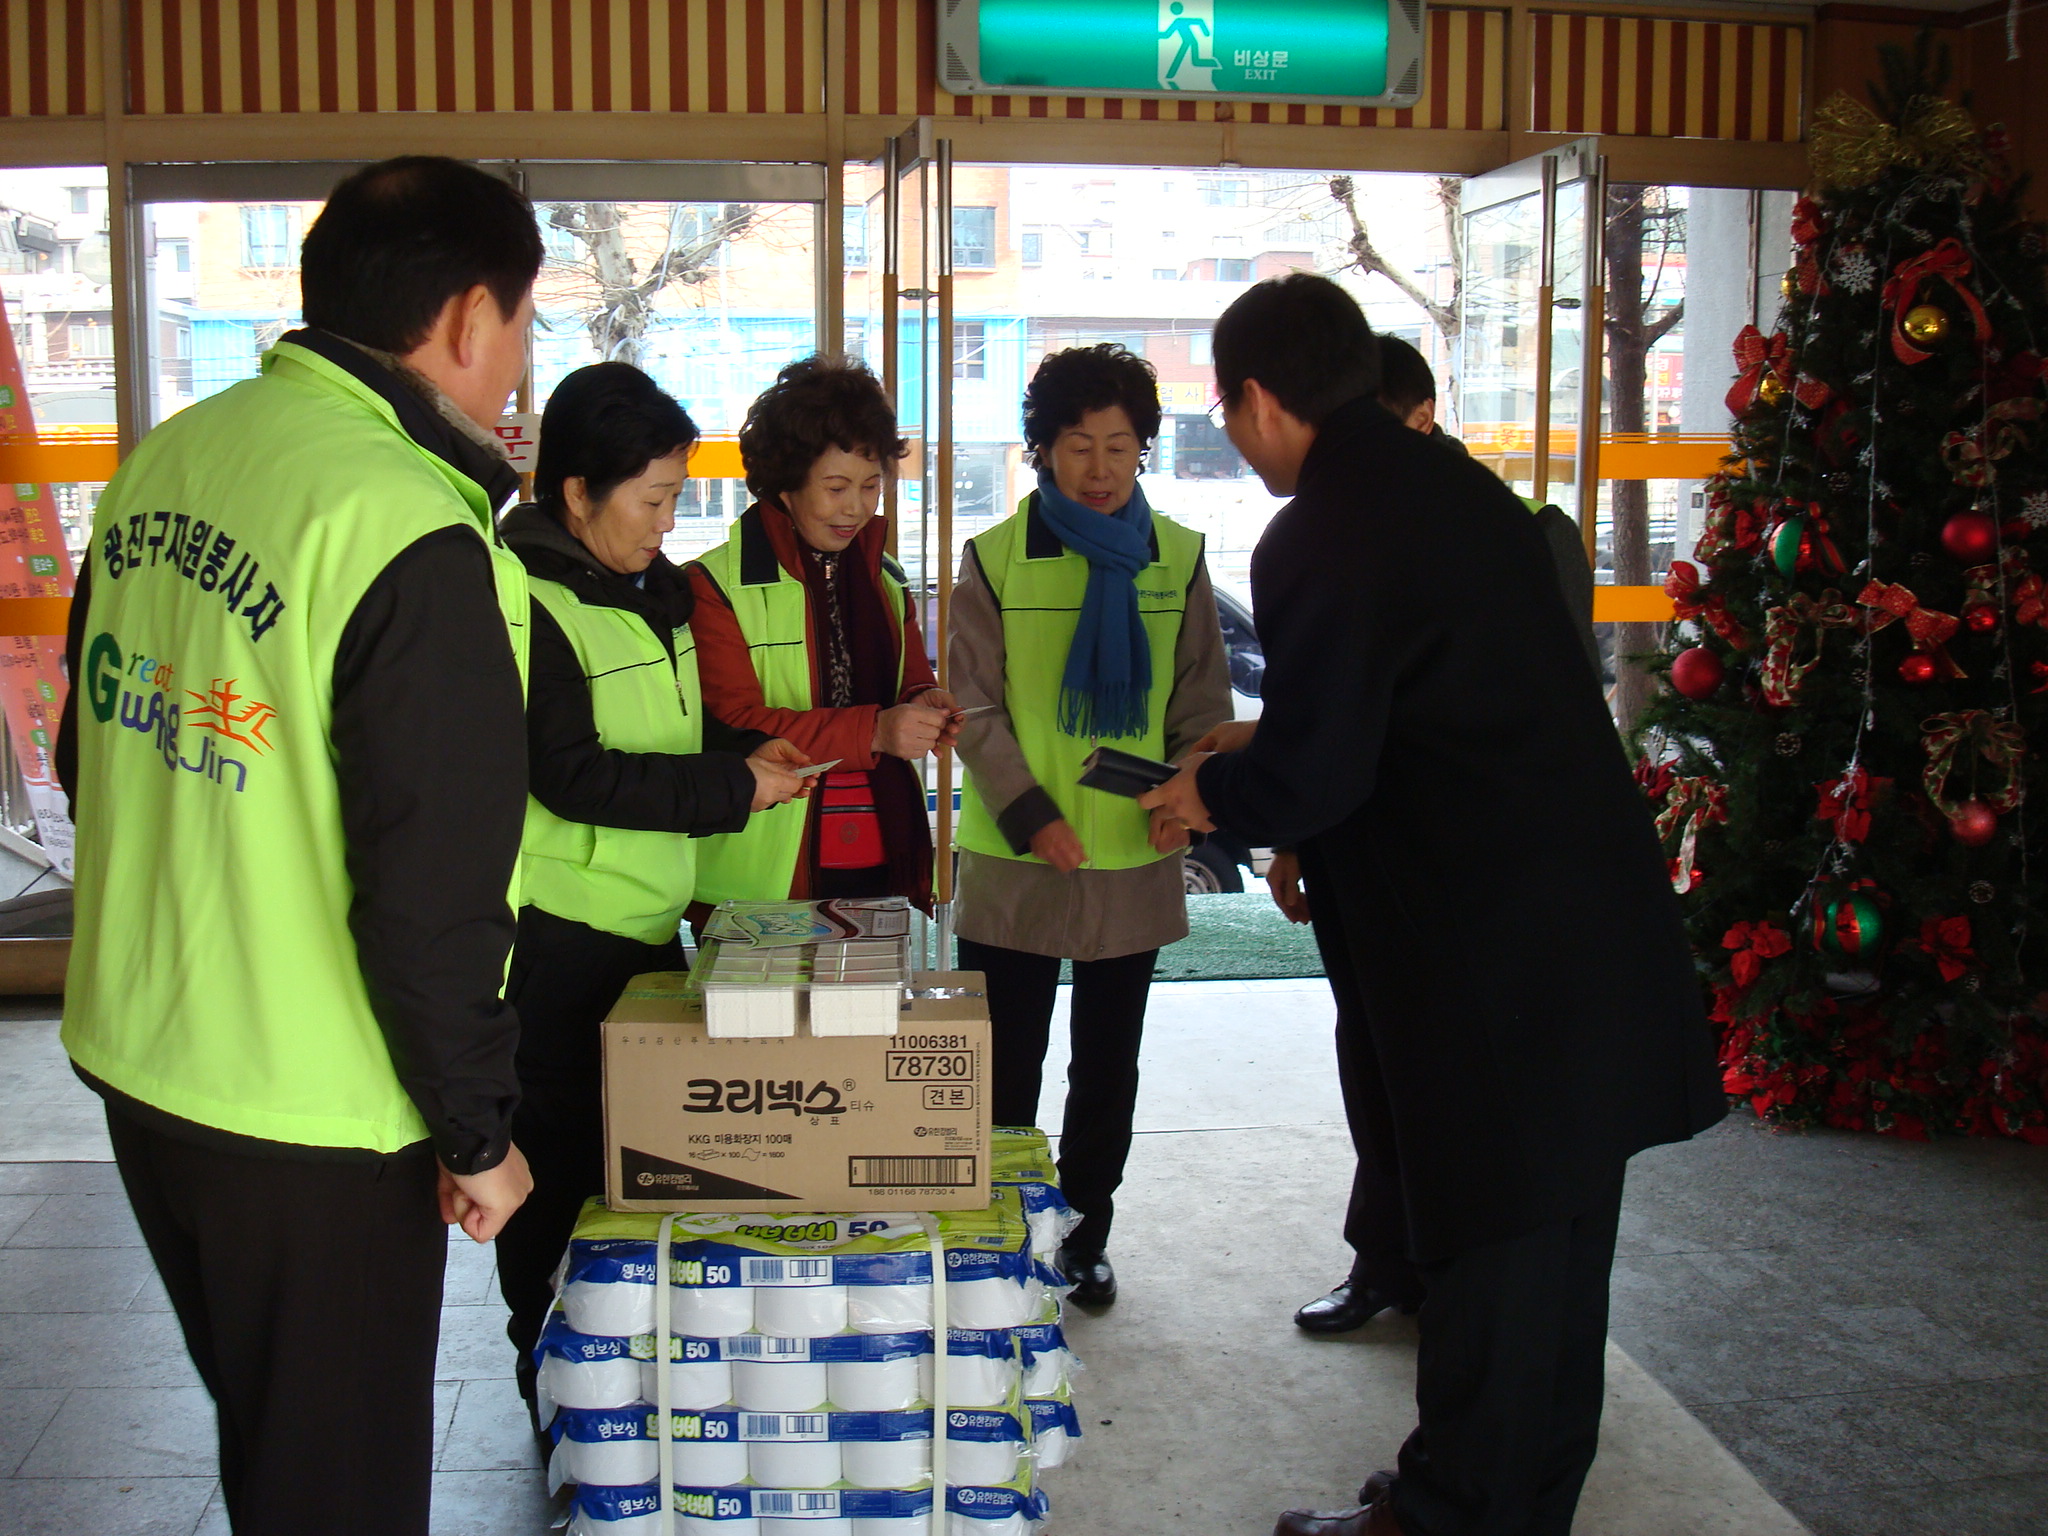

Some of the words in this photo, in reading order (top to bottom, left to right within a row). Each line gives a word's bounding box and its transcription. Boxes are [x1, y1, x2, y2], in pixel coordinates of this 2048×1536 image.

[1234, 50, 1288, 67] 비상문
[1244, 69, 1277, 80] EXIT
[494, 426, 533, 460] 문
[104, 511, 285, 643] 광진구자원봉사자
[889, 1035, 968, 1049] 11006381
[892, 1055, 967, 1077] 78730
[682, 1078, 848, 1117] 크리넥스
[850, 1099, 875, 1112] 티슈
[688, 1134, 711, 1145] KKG
[714, 1133, 762, 1145] 미용화장지
[765, 1133, 793, 1145] 100매
[728, 1151, 741, 1159] 100
[962, 1253, 1000, 1265] 유한킴벌리
[622, 1263, 656, 1281] 엠보싱
[670, 1259, 704, 1285] 삐
[706, 1265, 731, 1284] 50
[582, 1341, 621, 1359] 엠보싱
[686, 1342, 710, 1359] 50
[598, 1422, 638, 1439] 엠보싱
[704, 1421, 729, 1438] 50
[618, 1496, 657, 1515] 엠보싱
[718, 1498, 742, 1515] 50
[976, 1491, 1015, 1505] 유한킴벌리
